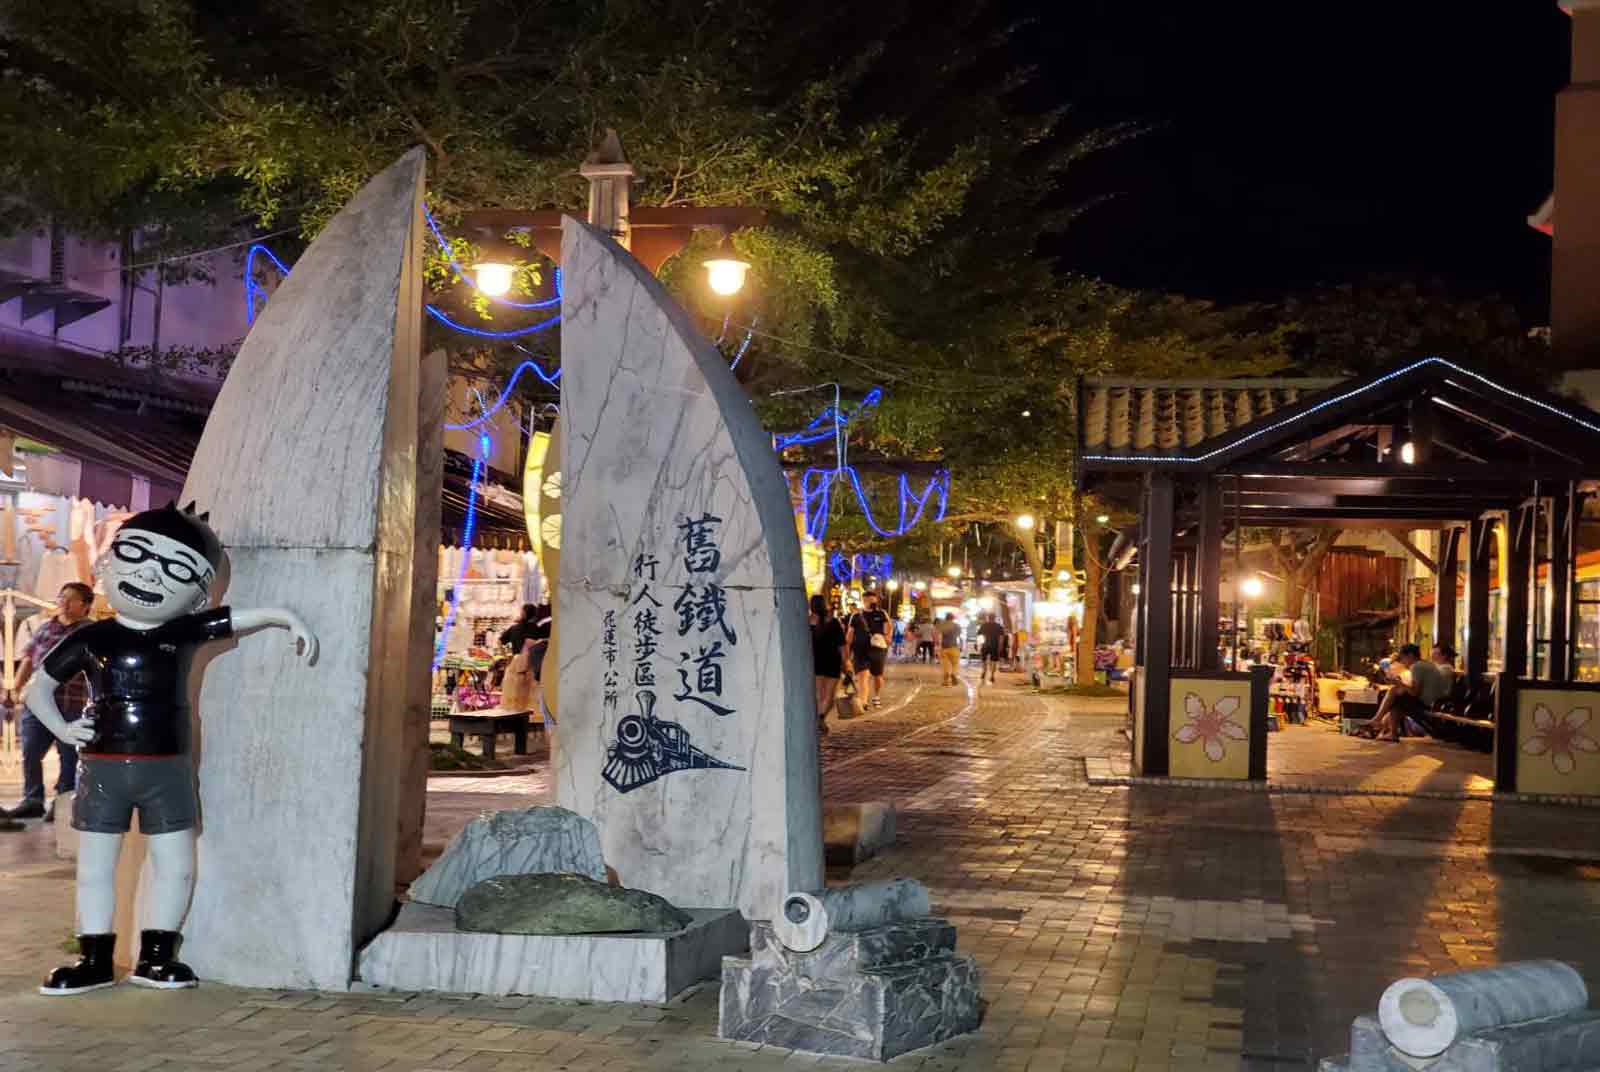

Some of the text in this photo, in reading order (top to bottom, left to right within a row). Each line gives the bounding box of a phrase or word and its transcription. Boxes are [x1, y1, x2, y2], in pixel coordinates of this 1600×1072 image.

[601, 609, 618, 710] 花蓮市公所
[632, 552, 663, 687] 行人徒步區
[673, 511, 738, 717] 舊鐵道
